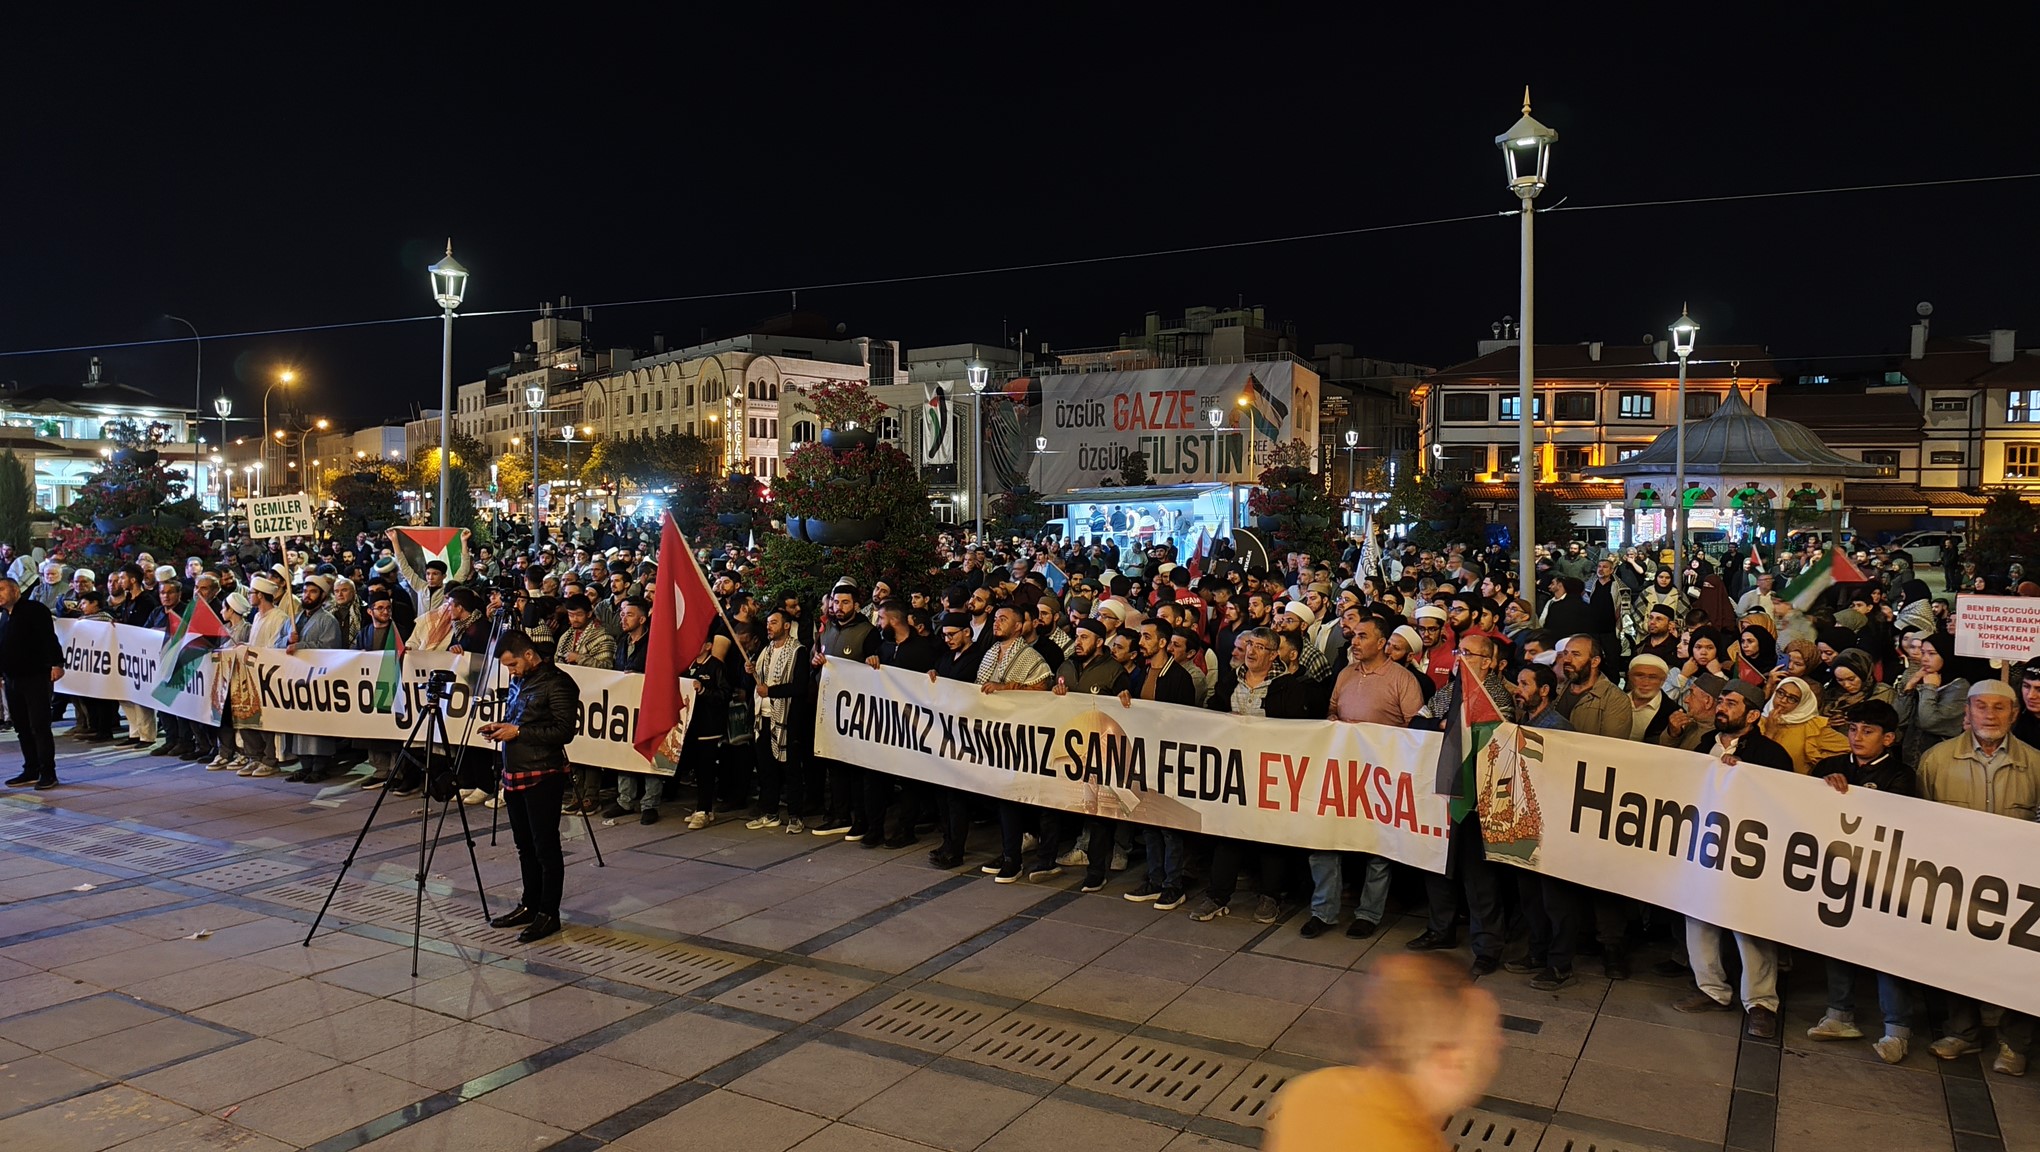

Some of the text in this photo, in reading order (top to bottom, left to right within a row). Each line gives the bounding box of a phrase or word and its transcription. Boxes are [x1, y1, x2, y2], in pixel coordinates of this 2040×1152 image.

[1055, 389, 1196, 431] ÖZGÜR GAZZE
[1078, 434, 1244, 475] ÖZGÜR FİLİSTİN
[253, 498, 302, 517] GEMİLER
[254, 516, 308, 534] GAZZE'ye
[1962, 614, 2014, 622] BULUTLARA
[1978, 623, 2028, 632] ŞİMŞEKTEN
[1979, 633, 2035, 642] KORKMAMAK
[1982, 641, 2031, 651] İSTİYORUM
[65, 638, 111, 675] denize
[118, 644, 156, 690] özgür
[258, 664, 350, 713] Kudüs
[835, 690, 934, 755] CANIMIZ
[1064, 729, 1148, 792] SANA
[1157, 740, 1247, 806] FEDA
[1258, 752, 1310, 812] EY
[1570, 760, 2040, 953] Hamas eğilmez
